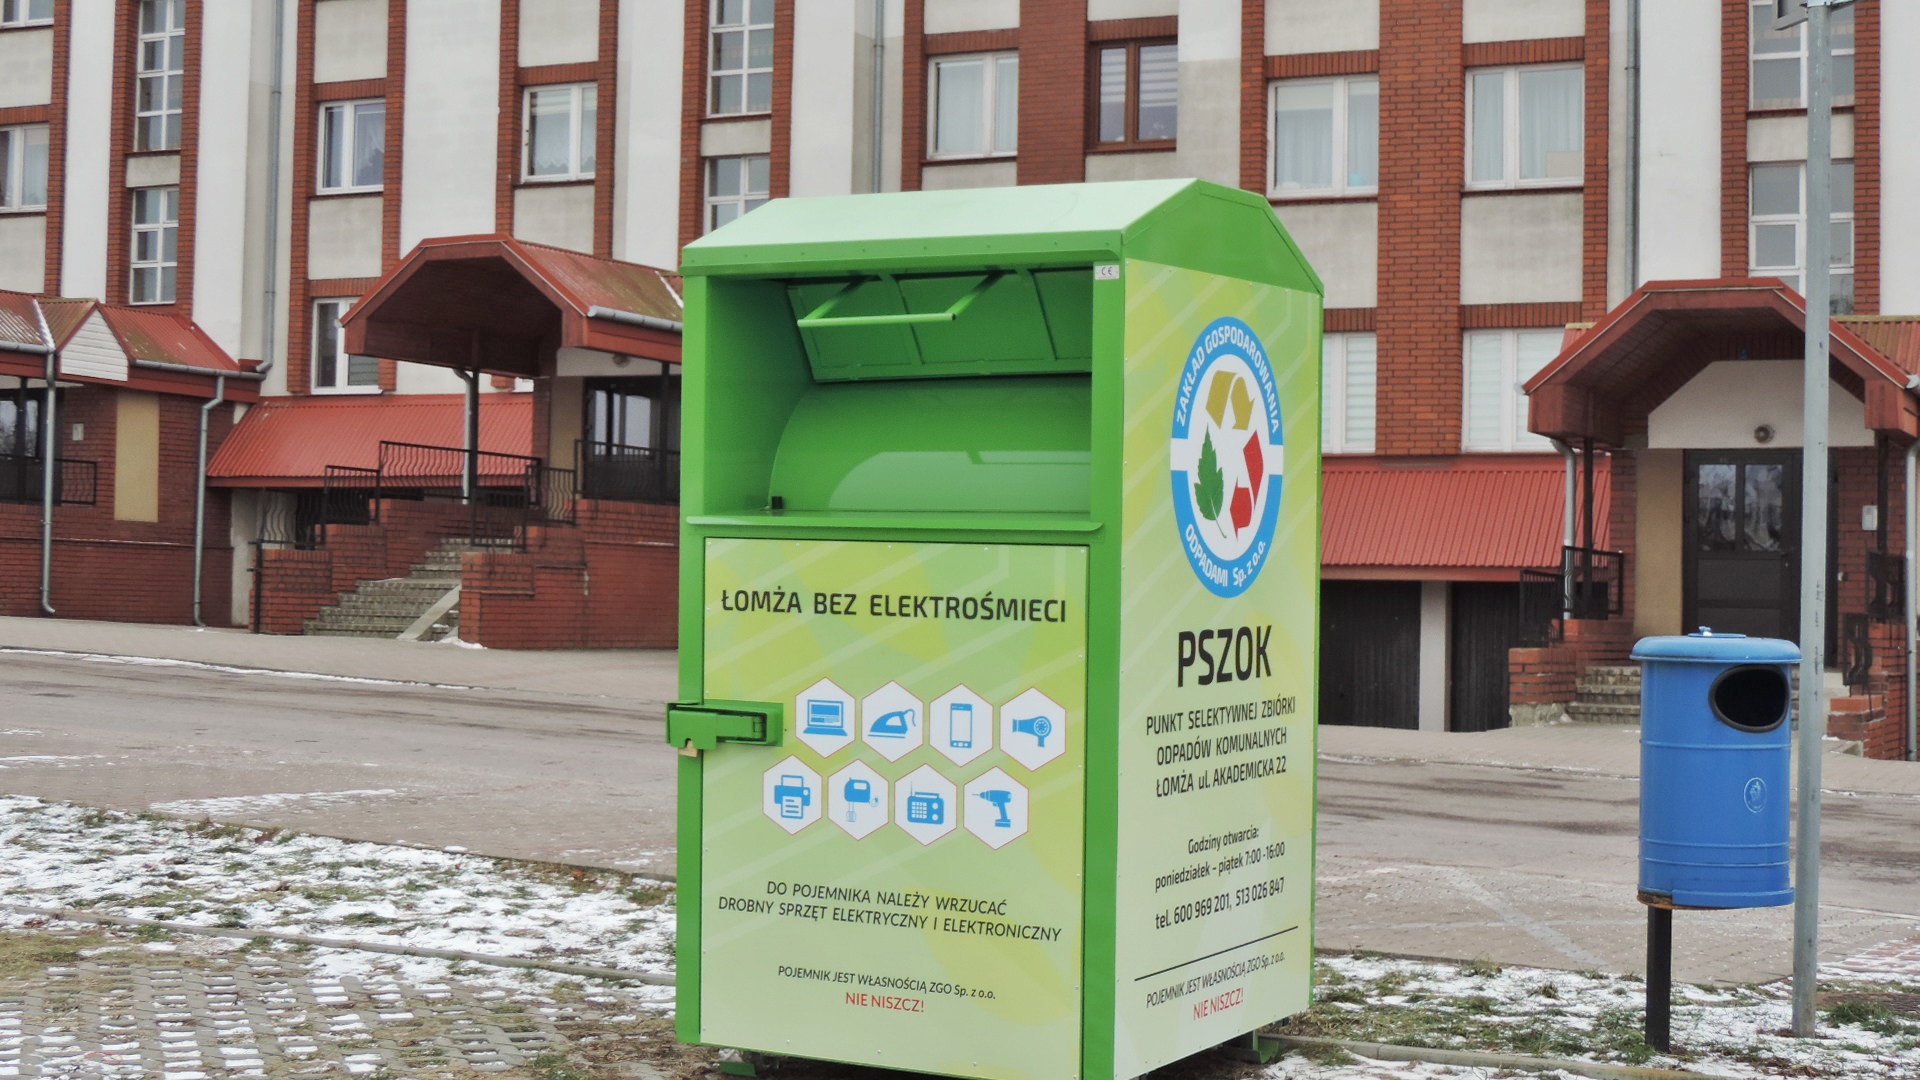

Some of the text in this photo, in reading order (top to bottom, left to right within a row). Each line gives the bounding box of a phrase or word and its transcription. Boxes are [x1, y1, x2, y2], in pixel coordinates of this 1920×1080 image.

[1177, 326, 1279, 433] ZAKŁAD GOSPODAROWANIA
[1186, 524, 1266, 587] ODPADAMI Sp. z o.o.
[721, 586, 1066, 622] ŁOMŻA BEZ ELEKTROŚMIECI
[1178, 625, 1272, 688] PSZOK
[1146, 693, 1296, 736] PUNKT SELEKTYWNEJ ZBIÓRKI
[1157, 727, 1286, 766] ODPADÓW KOMUNALNYCH
[1156, 756, 1286, 798] ŁOMŻA ul. AKADEMICKA 22
[1188, 824, 1259, 854] Godziny otwarcia:
[1155, 861, 1210, 893] poniedziałek
[1219, 853, 1243, 876] piątek
[1245, 848, 1261, 866] 7:00
[718, 896, 1062, 942] DROBNY SPRZĘT ELEKTRYCZNY I ELEKTRONICZNY
[767, 881, 1007, 916] DO POJEMNIKA NALEŻY WRZUCAĆ
[1155, 877, 1284, 929] tel. 600 969 201, 513 026 847
[778, 966, 996, 1000] POJEMNIK JEST WŁASNOŚCIĄ ZGO Sp. z o.o.
[1146, 982, 1185, 1008] POJEMNIK
[1186, 977, 1200, 995] JEST
[1202, 962, 1246, 988] WŁASNOŚCIĄ
[1247, 957, 1260, 974] ZGO
[1261, 954, 1270, 970] Sp.
[1275, 952, 1286, 962] o.o.
[846, 992, 924, 1012] NIE NISZCZ!
[1193, 988, 1244, 1020] NIE NISZCZ!
